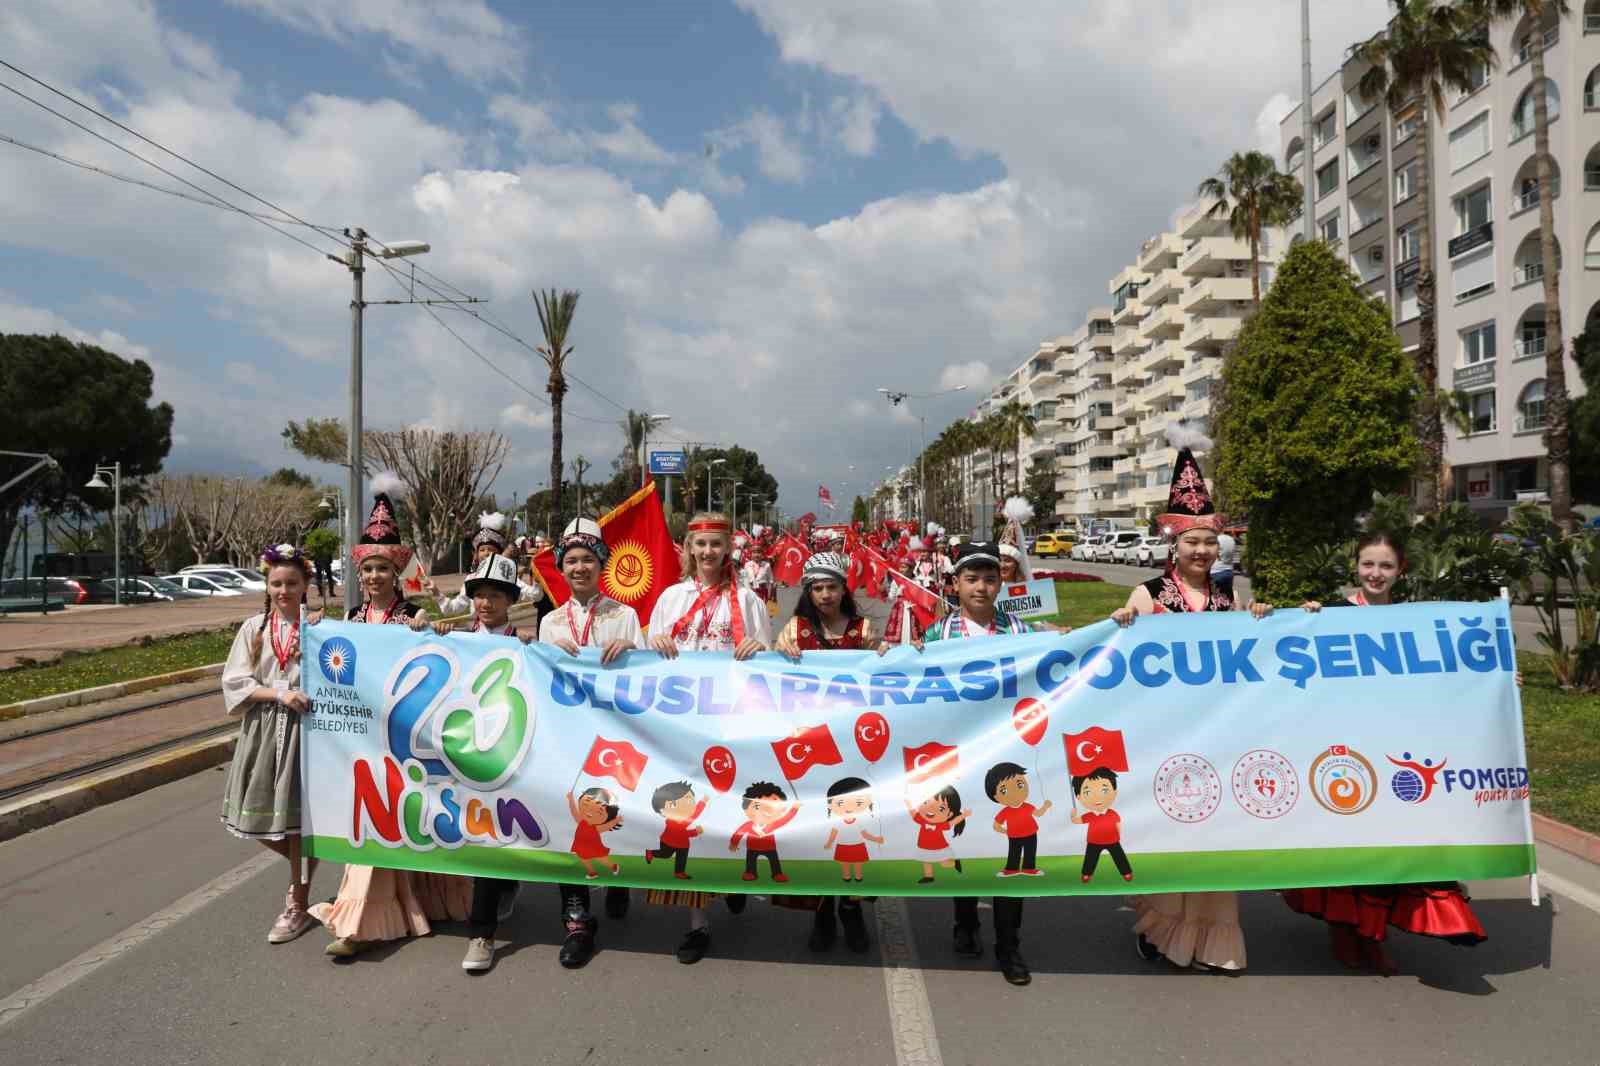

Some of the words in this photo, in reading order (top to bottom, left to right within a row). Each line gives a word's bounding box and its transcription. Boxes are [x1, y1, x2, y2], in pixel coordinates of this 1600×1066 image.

[550, 656, 1018, 716] ULUSLARARASI
[1275, 616, 1514, 690] ŞENLİĞİ
[316, 687, 360, 702] ANTALYA
[308, 699, 374, 719] ÜYÜKŞEHİR
[386, 650, 530, 784] 23
[311, 718, 368, 735] BELEDİYESİ
[1443, 767, 1529, 793] FOMGED
[353, 756, 544, 846] Nisan
